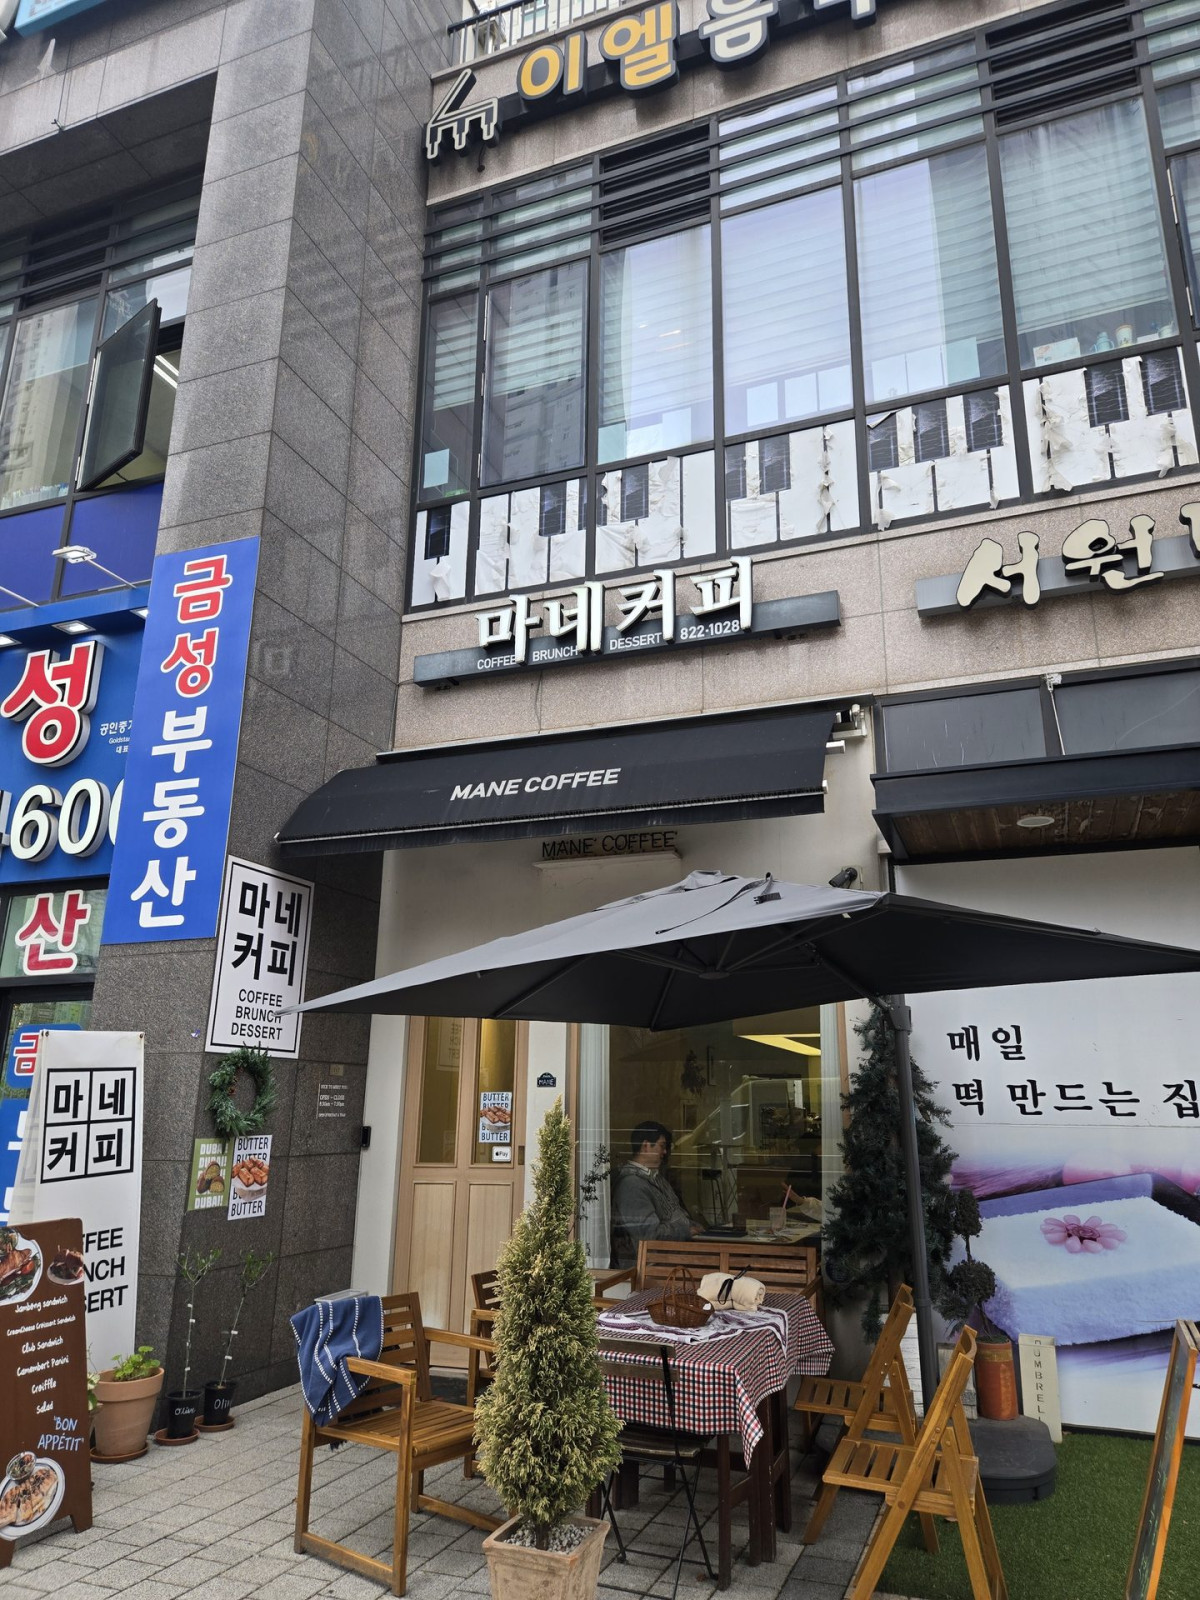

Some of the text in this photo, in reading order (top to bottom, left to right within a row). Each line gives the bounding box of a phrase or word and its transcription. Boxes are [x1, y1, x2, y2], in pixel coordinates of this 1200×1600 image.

[474, 556, 752, 665] 마네커피
[477, 655, 517, 670] COFFEE
[532, 646, 578, 662] BRUNCH
[609, 632, 662, 650] DESSERT
[450, 768, 621, 800] MANE COFFEE
[0, 778, 124, 862] 60
[602, 831, 676, 852] COFFEE
[239, 881, 303, 938] 마네
[231, 932, 298, 987] 커피
[238, 988, 283, 1008] COFFEE
[235, 1005, 282, 1024] BRUNCH
[230, 1022, 283, 1041] DESSERT
[947, 1025, 1025, 1062] 매일
[53, 1077, 126, 1119] 마네
[482, 1092, 510, 1102] BUTTER
[952, 1079, 1200, 1118] 떡 만드는 집
[237, 1136, 269, 1151] BUTTER
[481, 1132, 508, 1142] BUTTER
[46, 1128, 123, 1173] 커피
[231, 1200, 263, 1217] BUTTER
[21, 1342, 36, 1354] Club
[50, 1354, 70, 1368] Panini
